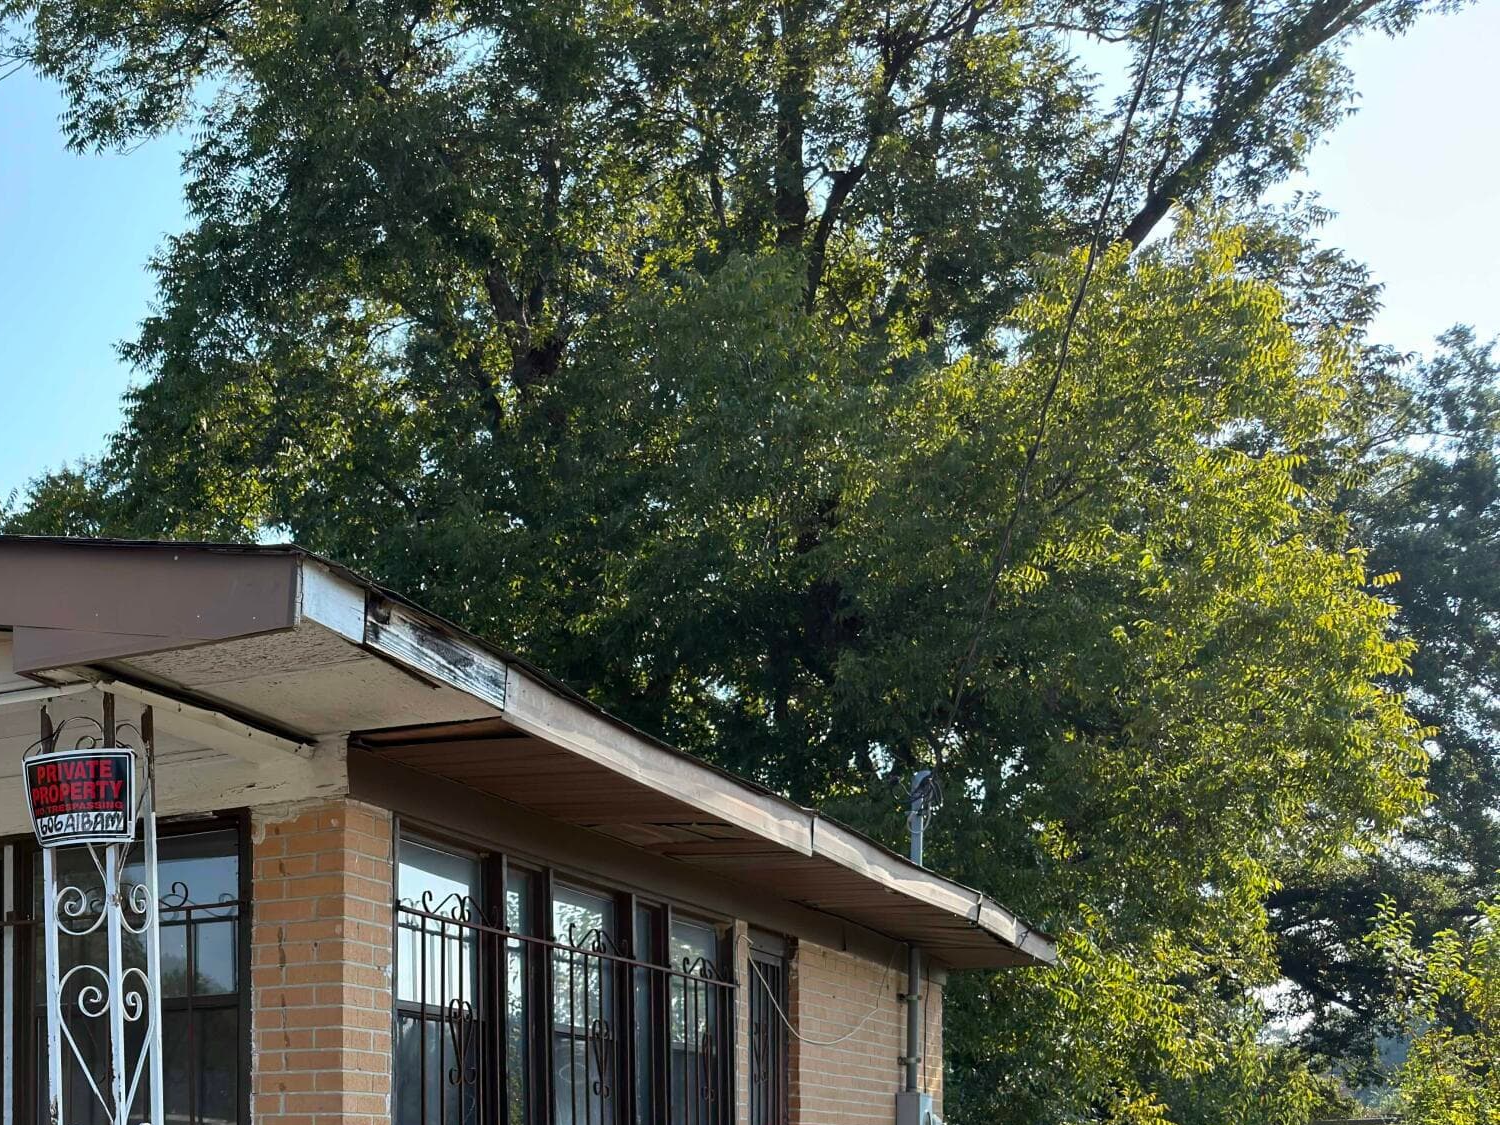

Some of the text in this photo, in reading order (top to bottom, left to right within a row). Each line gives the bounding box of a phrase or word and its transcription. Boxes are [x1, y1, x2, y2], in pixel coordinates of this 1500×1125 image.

[37, 759, 112, 784] PRIVATE
[32, 781, 124, 806] PROPERTY
[36, 801, 124, 817] NO TRESPASSING
[40, 815, 63, 835] 606
